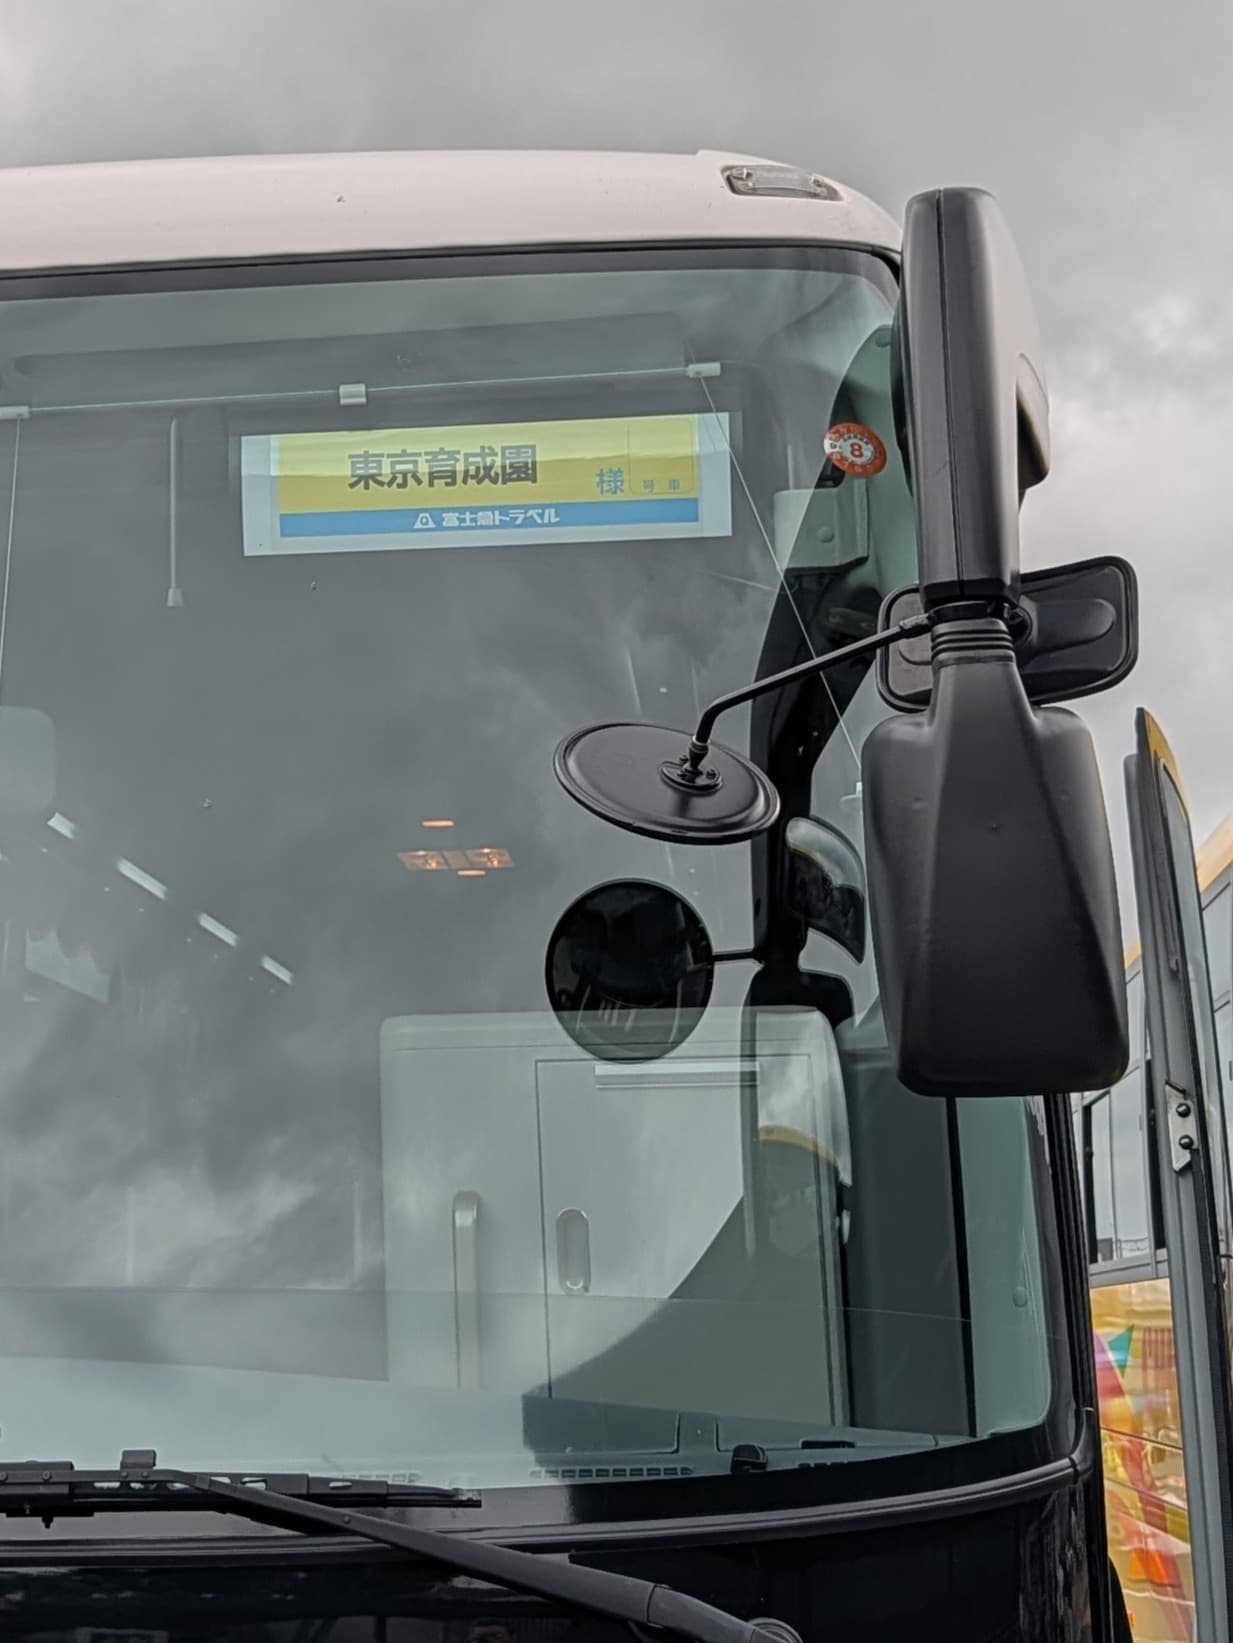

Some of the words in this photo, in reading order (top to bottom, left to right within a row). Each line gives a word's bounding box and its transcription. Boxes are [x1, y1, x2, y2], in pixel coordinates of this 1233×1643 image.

[348, 445, 537, 490] 東京育成園
[596, 467, 624, 496] 様
